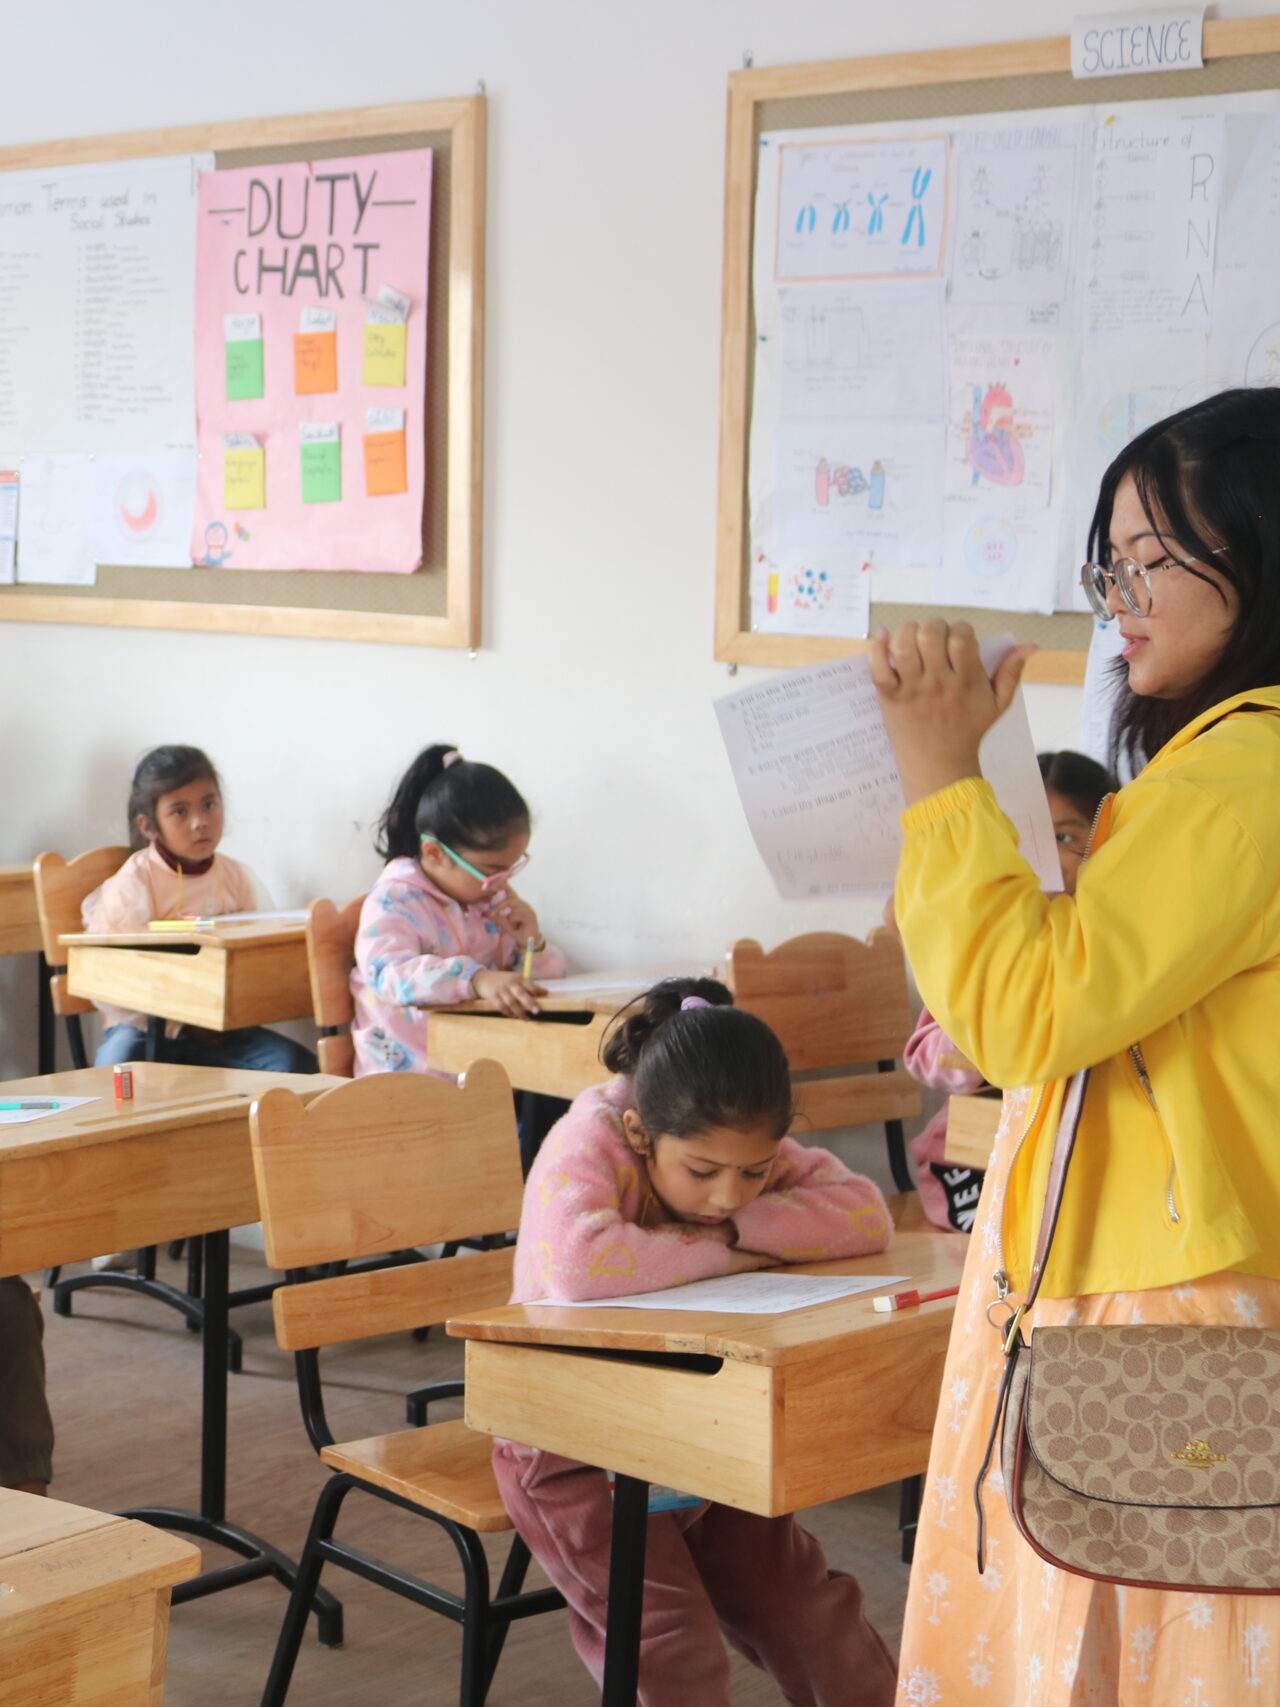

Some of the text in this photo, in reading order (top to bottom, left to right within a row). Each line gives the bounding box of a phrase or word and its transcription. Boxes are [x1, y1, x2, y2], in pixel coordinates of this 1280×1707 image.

[1082, 20, 1192, 73] SCIENCE
[41, 182, 88, 212] Terms
[99, 186, 130, 209] used
[247, 169, 378, 240] DUTY
[232, 242, 381, 300] CHART
